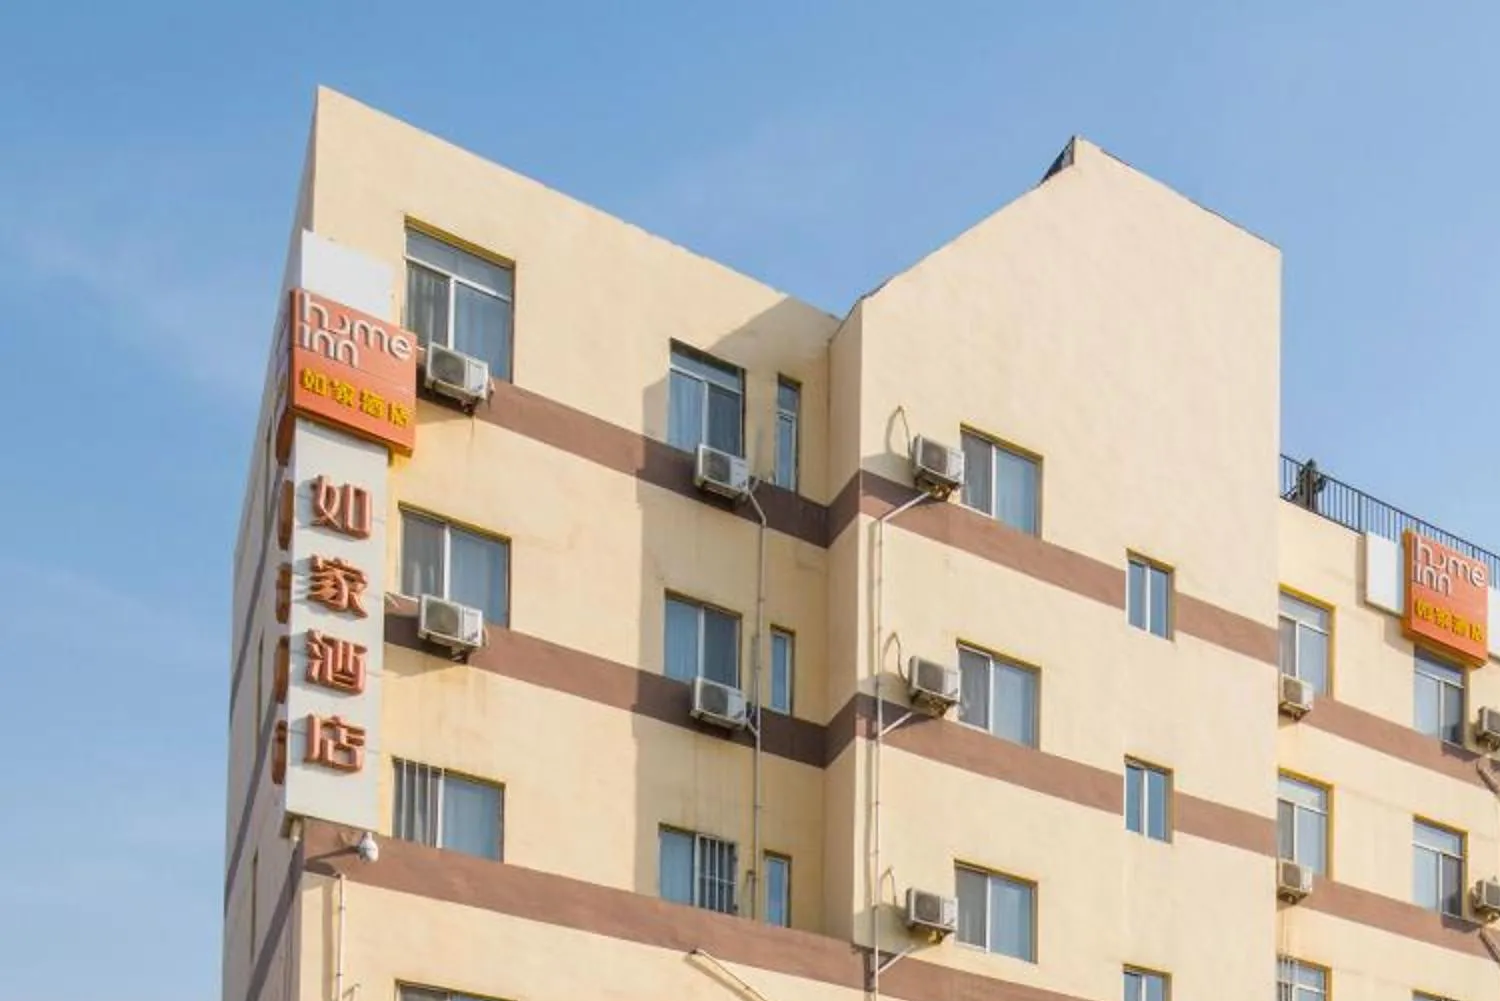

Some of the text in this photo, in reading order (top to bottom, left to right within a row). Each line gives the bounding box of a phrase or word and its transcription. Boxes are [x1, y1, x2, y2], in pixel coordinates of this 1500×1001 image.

[302, 324, 360, 369] inn
[301, 367, 410, 426] 如家酒店
[1414, 563, 1452, 597] inn
[304, 474, 373, 772] 如家酒店
